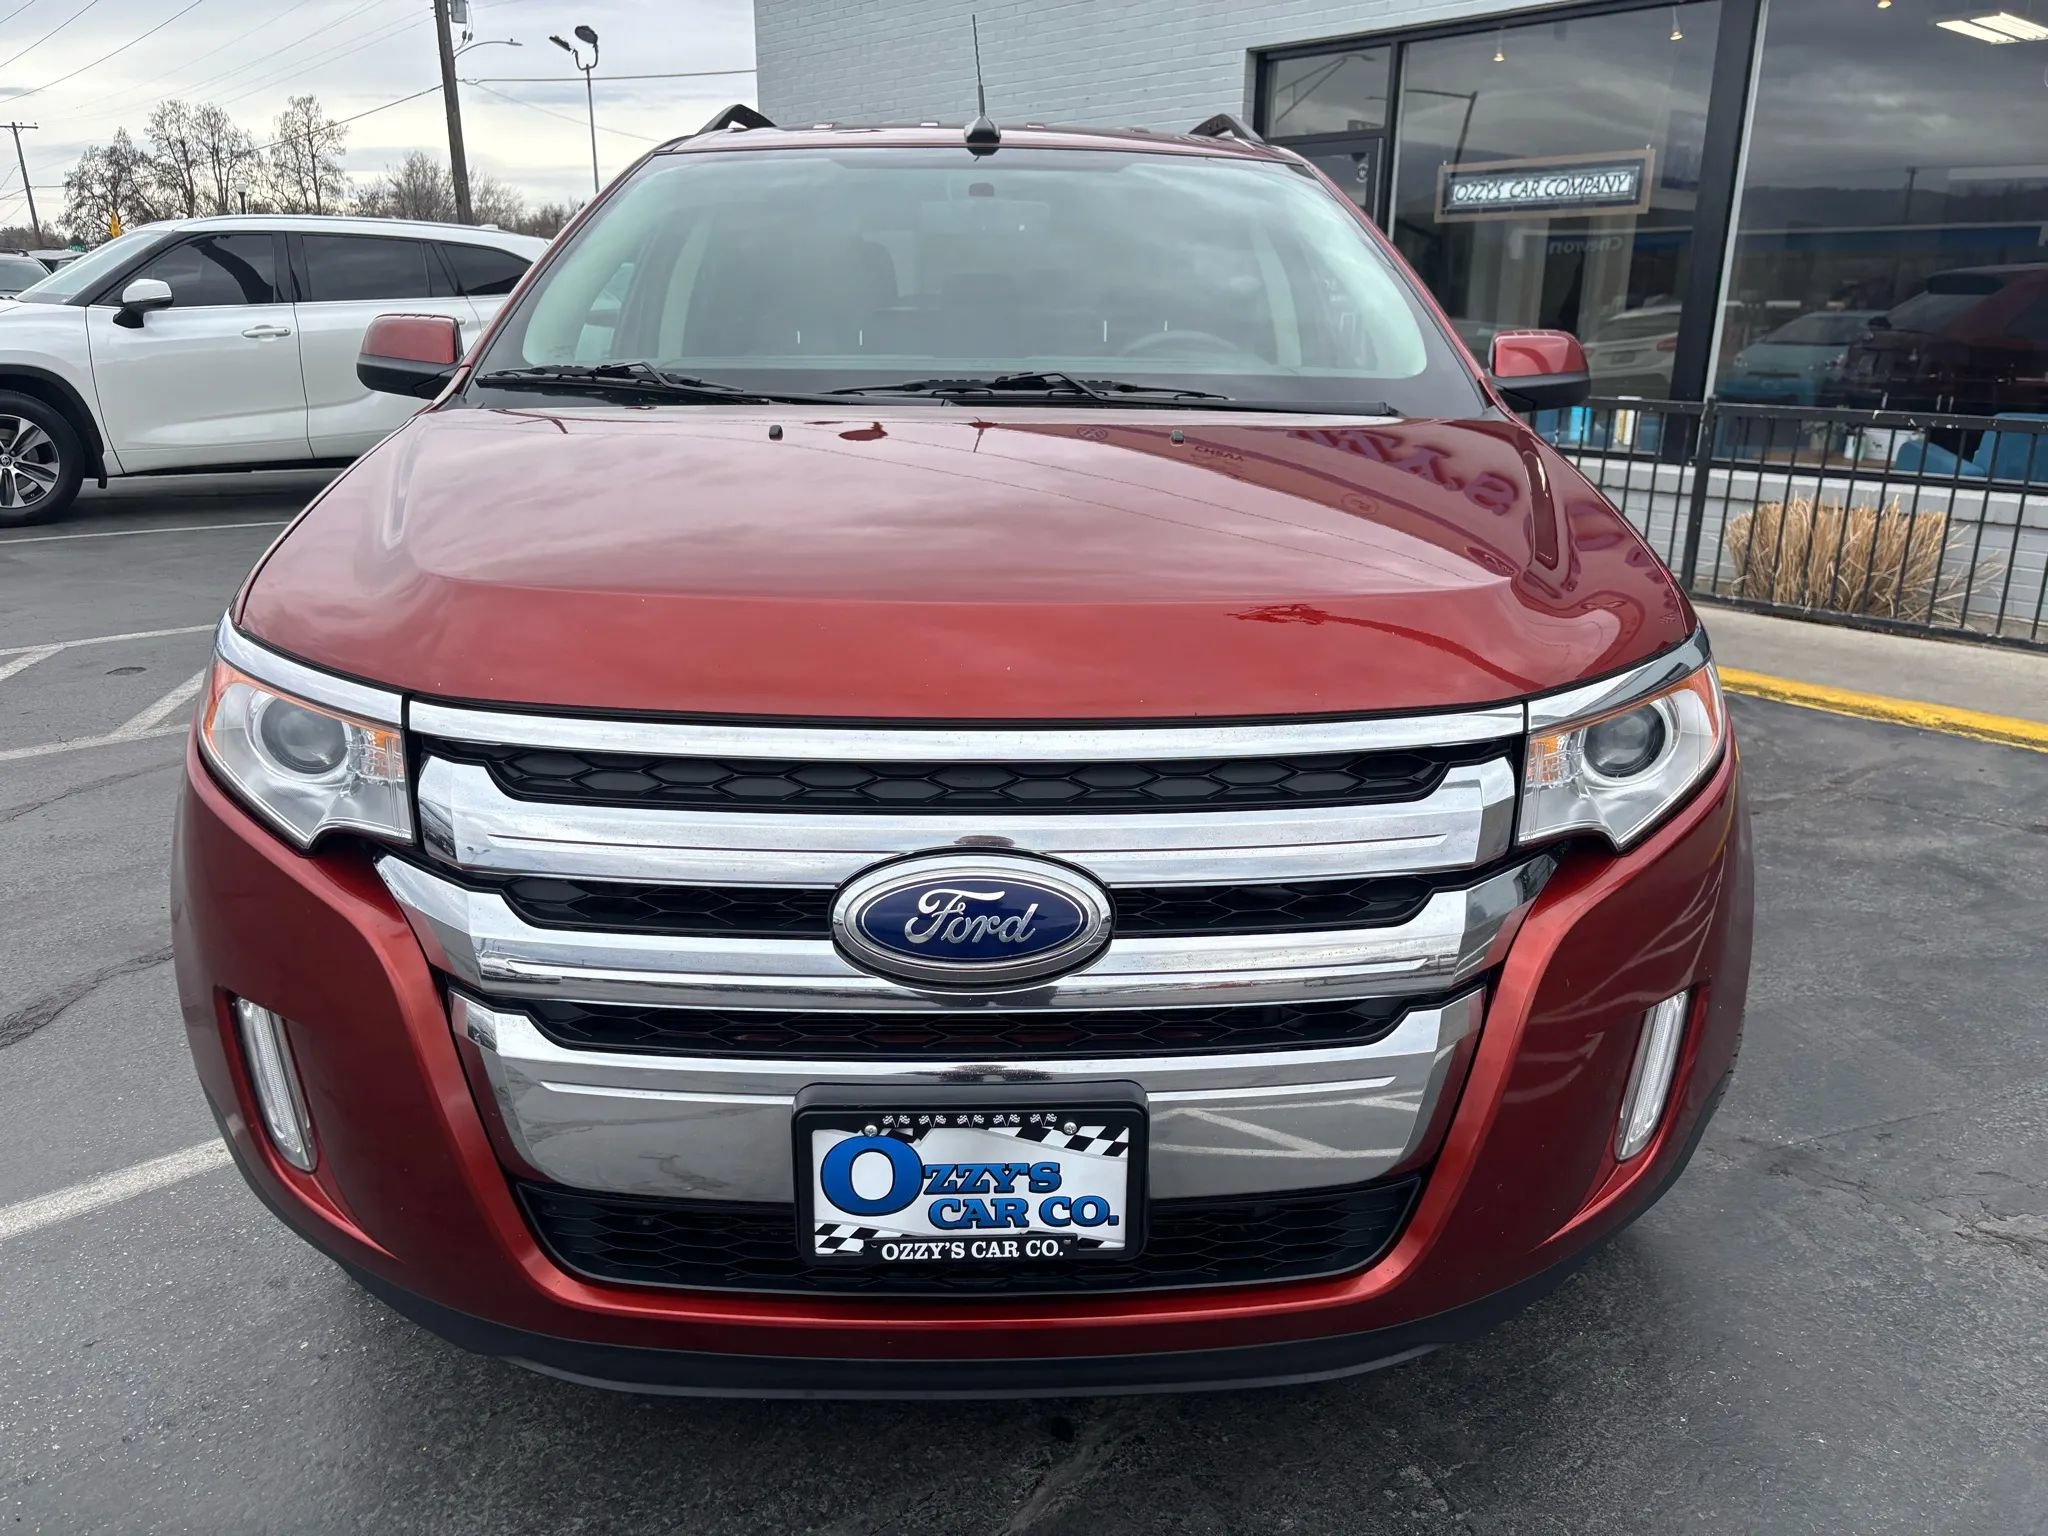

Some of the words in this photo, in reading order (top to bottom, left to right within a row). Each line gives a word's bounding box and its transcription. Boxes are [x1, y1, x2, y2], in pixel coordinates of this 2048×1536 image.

[1456, 182, 1502, 201] OZZY'S
[1510, 179, 1540, 199] CAR
[1544, 173, 1629, 196] COMPANY
[904, 888, 1039, 944] Ford
[927, 1197, 1030, 1230] CAR
[1038, 1195, 1120, 1228] CO.
[881, 1241, 966, 1261] OZZY'S
[971, 1240, 1020, 1259] CAR
[1025, 1239, 1064, 1257] CO.
